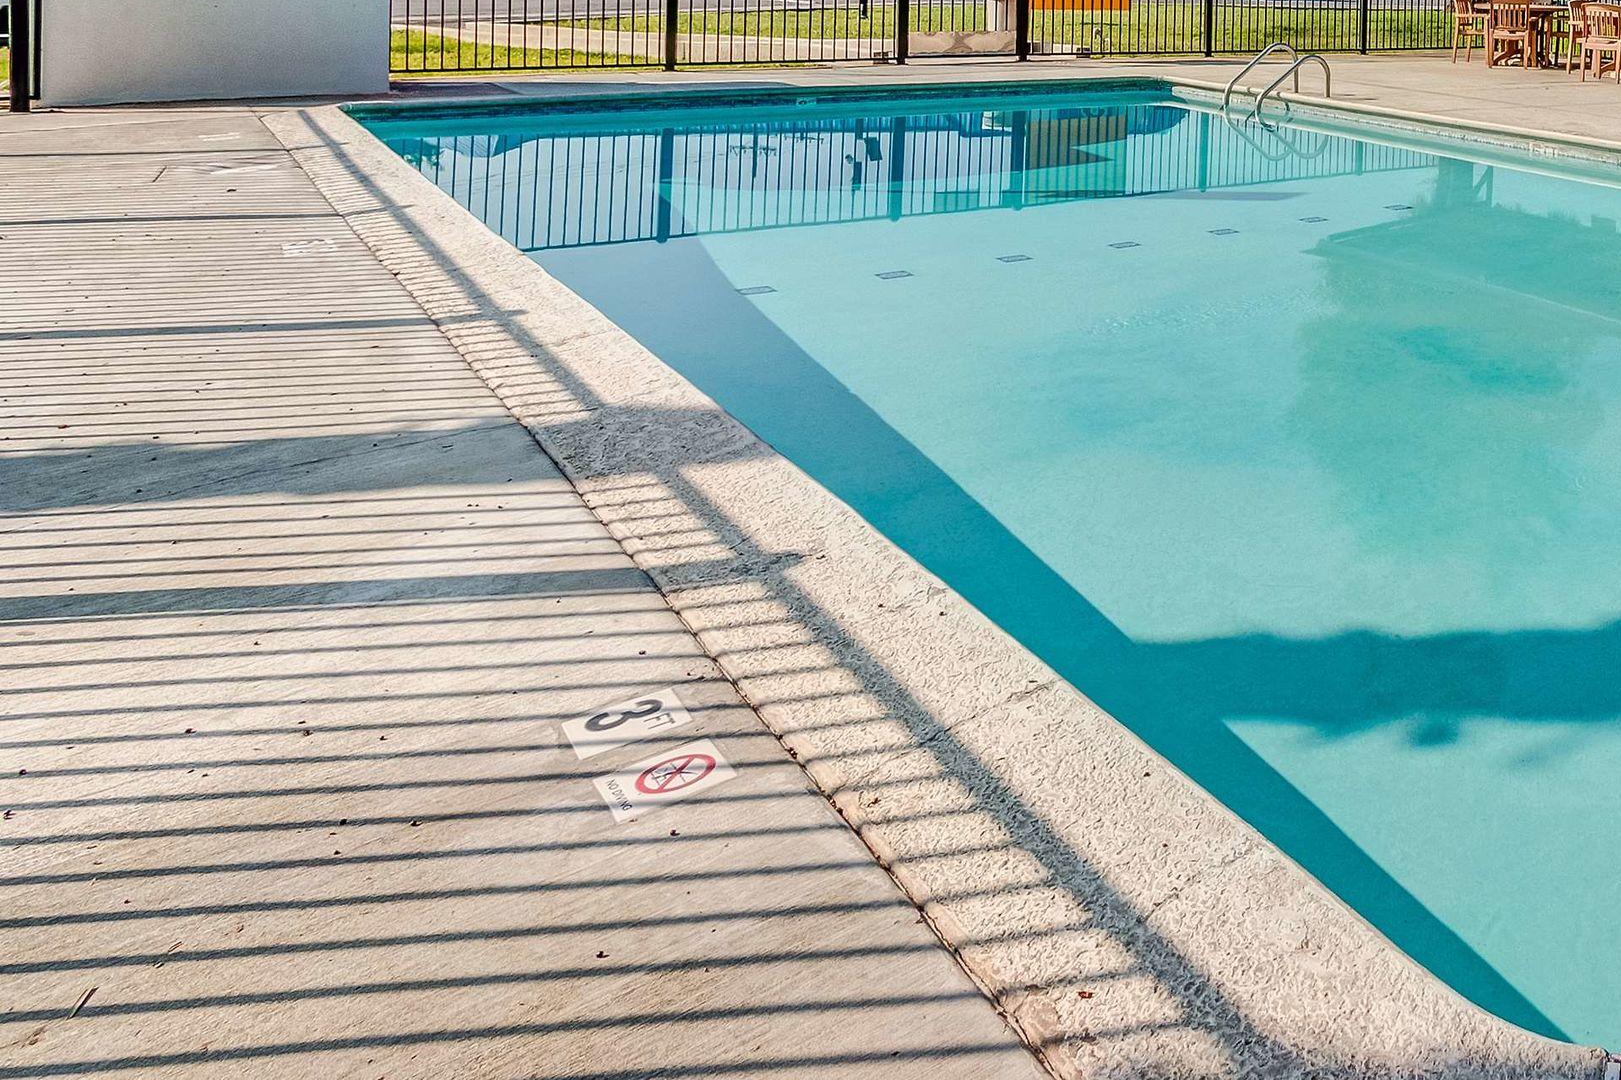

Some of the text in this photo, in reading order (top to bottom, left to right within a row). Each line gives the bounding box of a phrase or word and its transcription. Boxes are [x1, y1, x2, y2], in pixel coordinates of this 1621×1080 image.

[584, 699, 676, 732] 3 FT
[606, 778, 633, 811] NO DIVING
